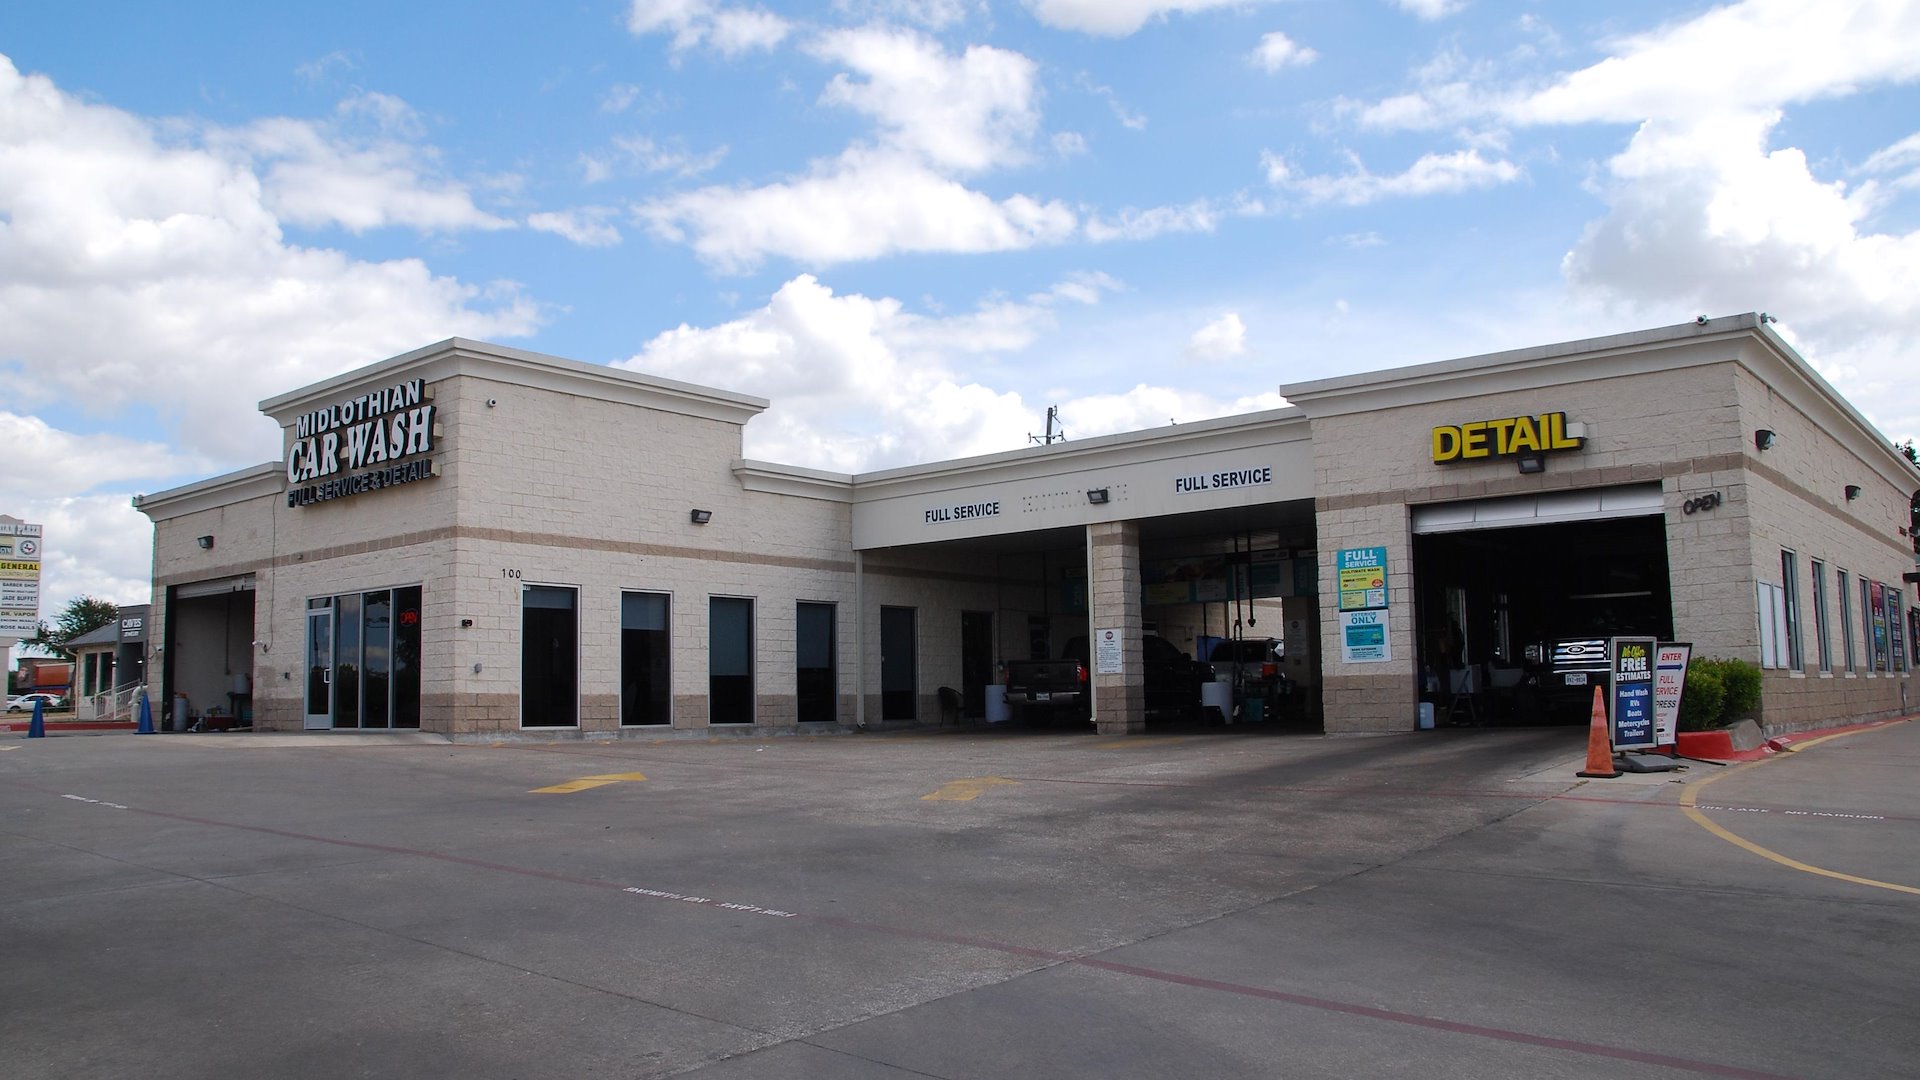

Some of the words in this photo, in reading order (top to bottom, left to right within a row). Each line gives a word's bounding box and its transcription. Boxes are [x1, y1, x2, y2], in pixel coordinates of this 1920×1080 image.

[295, 378, 425, 439] MIDLOTHIAN
[1432, 412, 1582, 464] DETAIL
[287, 432, 340, 484] CAR
[346, 405, 435, 469] WASH
[288, 486, 318, 508] FULL
[316, 473, 369, 502] SERVICE
[369, 470, 381, 490] &
[382, 459, 432, 488] DETAIL
[1175, 475, 1209, 493] FULL
[1212, 467, 1272, 488] SERVICE
[1682, 491, 1721, 515] OPEN
[925, 508, 951, 523] FULL
[953, 502, 1000, 519] SERVICE
[1345, 549, 1377, 561] FULL
[0, 562, 39, 570] GENERAL
[1345, 560, 1377, 568] SERVICE
[501, 568, 521, 579] 100
[1351, 616, 1377, 624] ONLY
[1661, 652, 1682, 661] ENTER
[1620, 657, 1647, 672] FREE
[1616, 671, 1652, 681] ESTIMATES
[1660, 675, 1674, 684] FULL
[1619, 689, 1635, 698] Hand
[1635, 688, 1649, 697] Wash
[1656, 687, 1679, 695] ERVICE
[1627, 709, 1643, 717] Boats
[1618, 718, 1650, 729] Motorcycles
